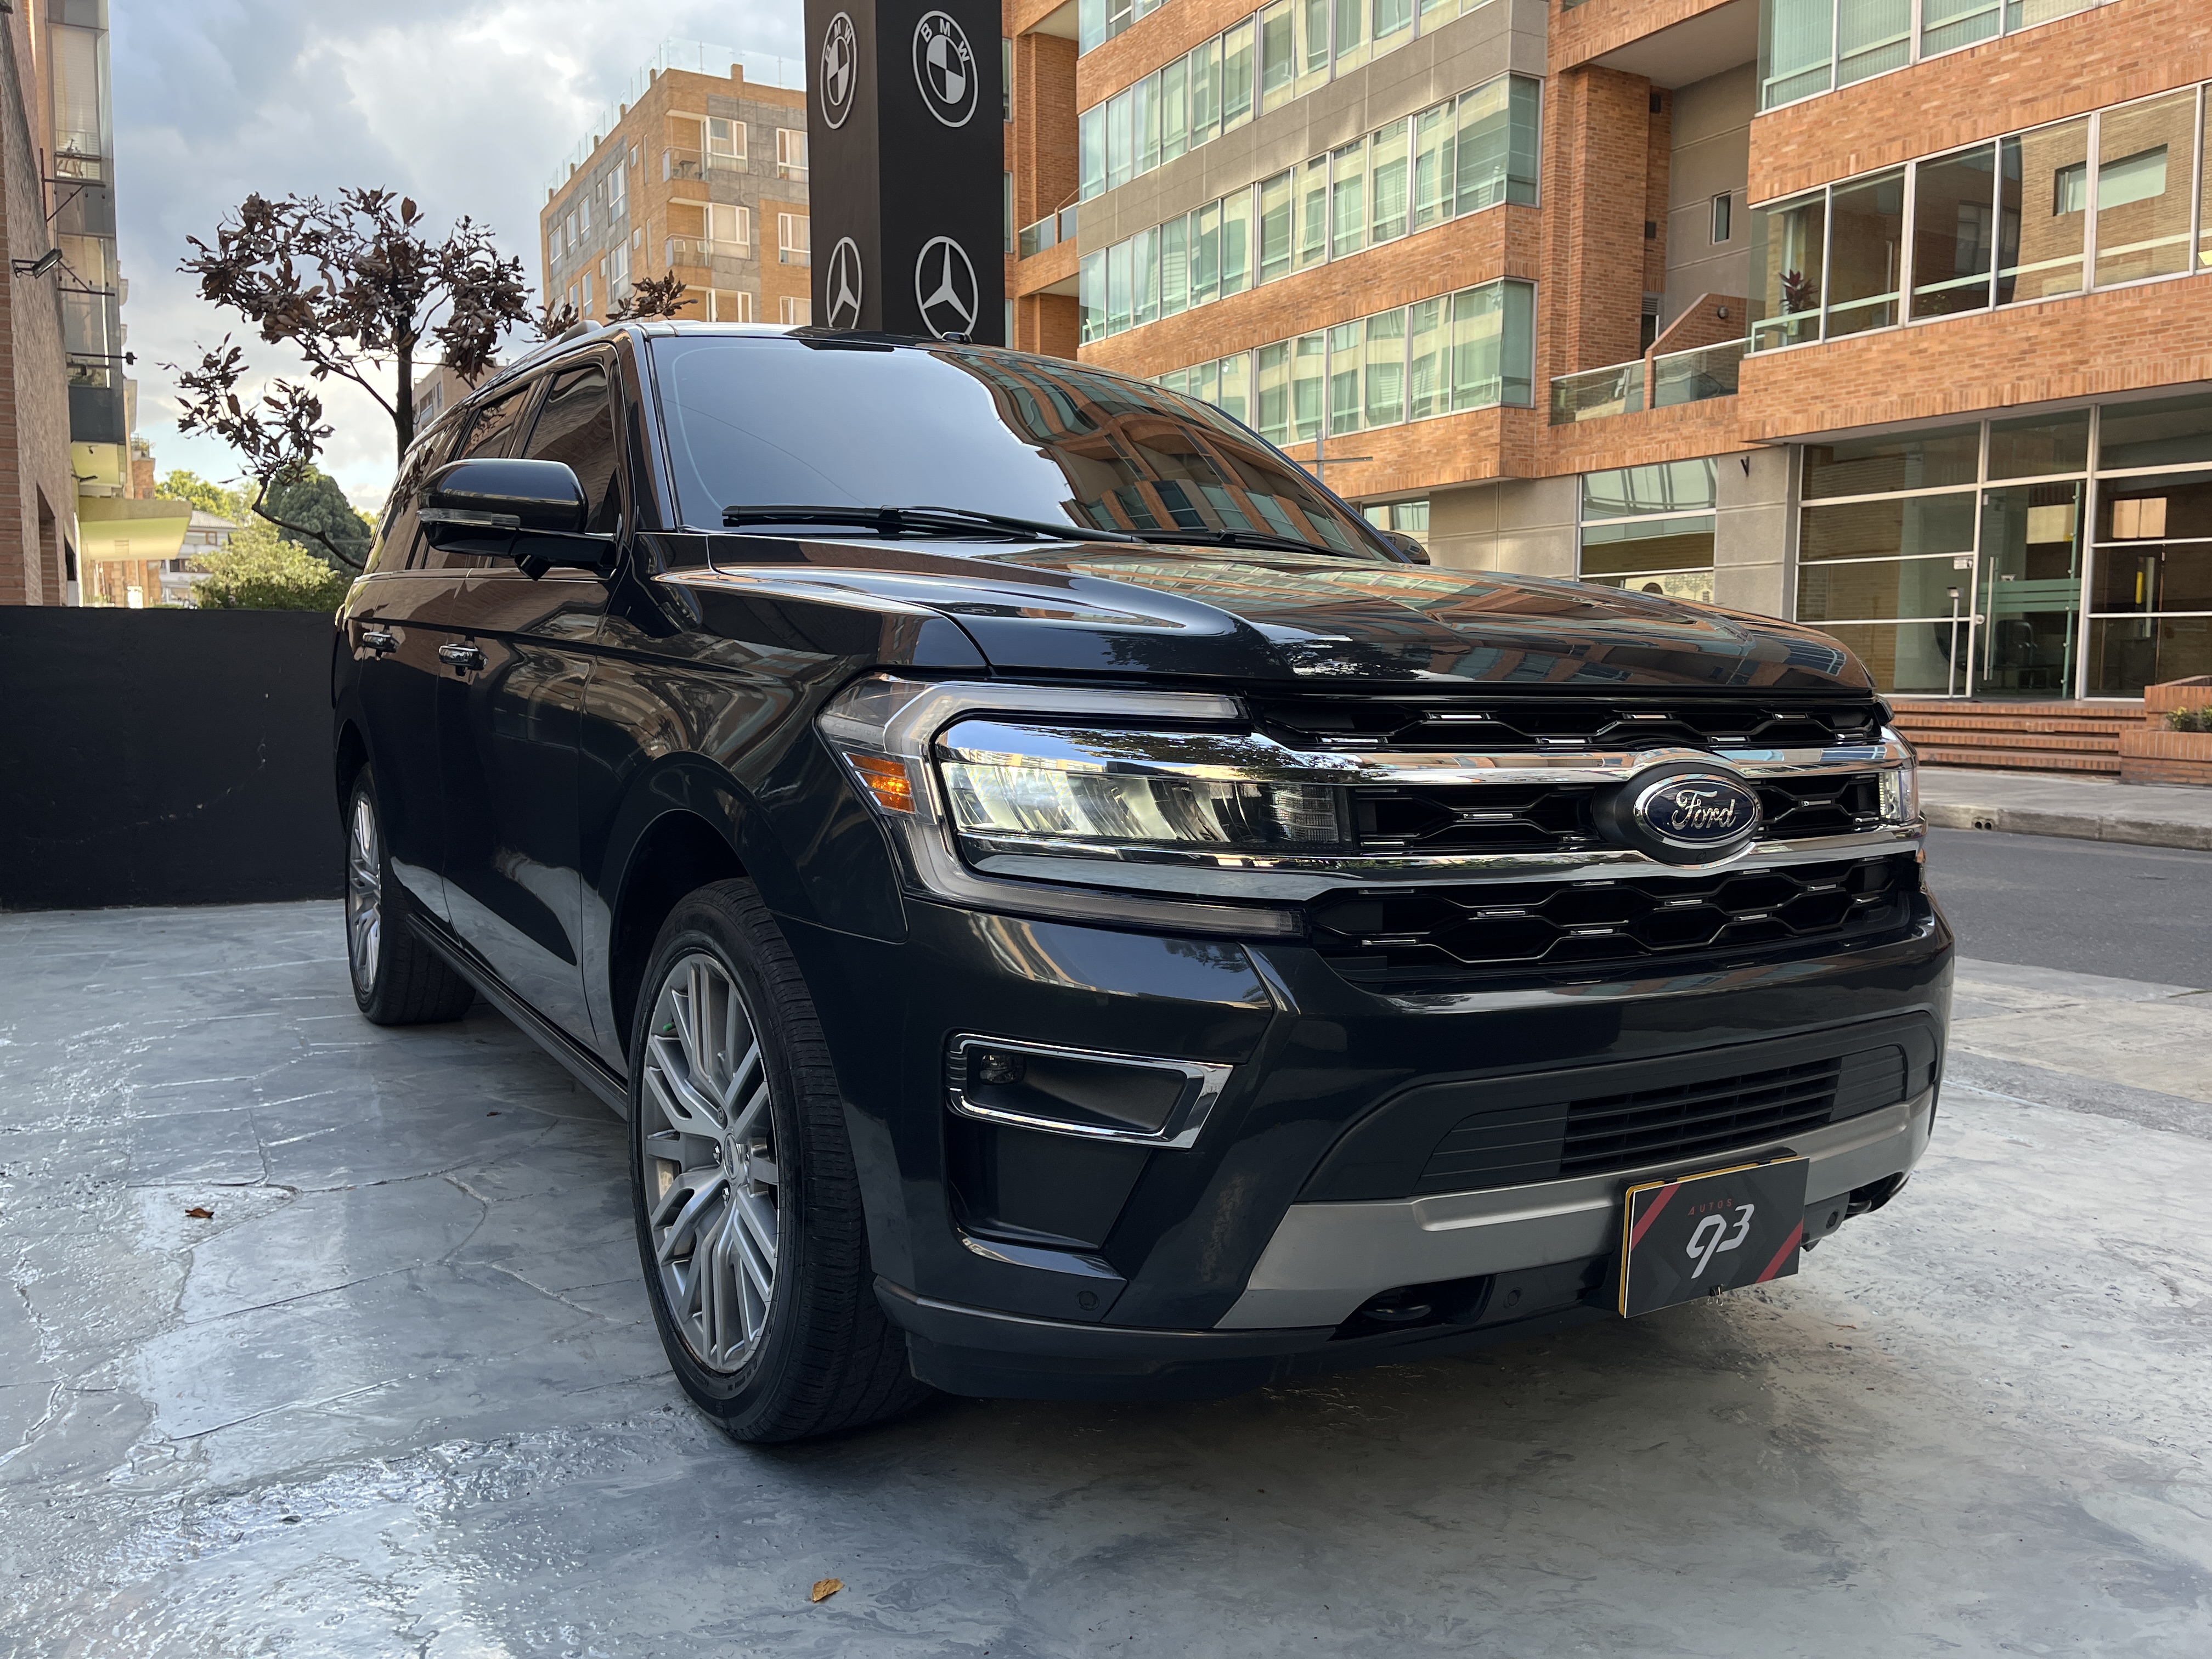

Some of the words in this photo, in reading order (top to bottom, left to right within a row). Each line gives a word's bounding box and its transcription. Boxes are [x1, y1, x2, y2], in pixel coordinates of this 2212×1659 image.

[825, 19, 853, 63] BMW
[920, 18, 970, 62] BMW
[1672, 789, 1736, 831] Ford
[1688, 1198, 1733, 1216] AUTOS
